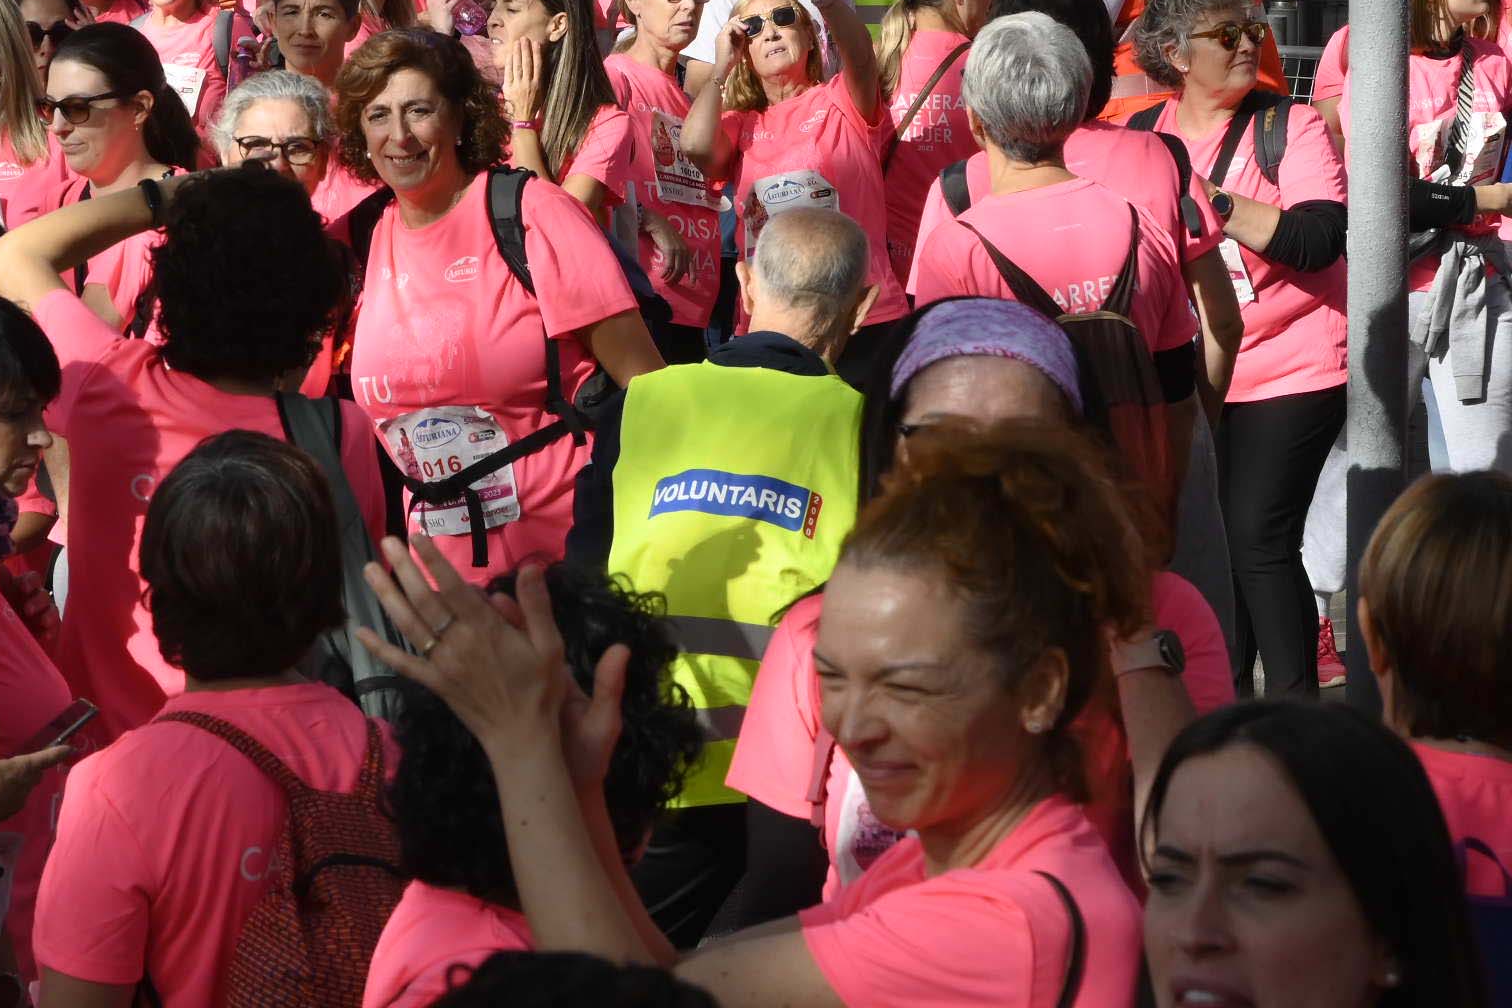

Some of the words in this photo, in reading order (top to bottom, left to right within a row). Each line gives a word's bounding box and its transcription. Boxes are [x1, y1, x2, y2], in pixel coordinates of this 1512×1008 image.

[928, 111, 951, 126] LA
[1051, 276, 1120, 307] ARRE
[359, 375, 393, 405] TU
[415, 426, 459, 444] ASTURIANA
[423, 454, 463, 480] 016
[654, 480, 802, 519] VOLUNTARIS
